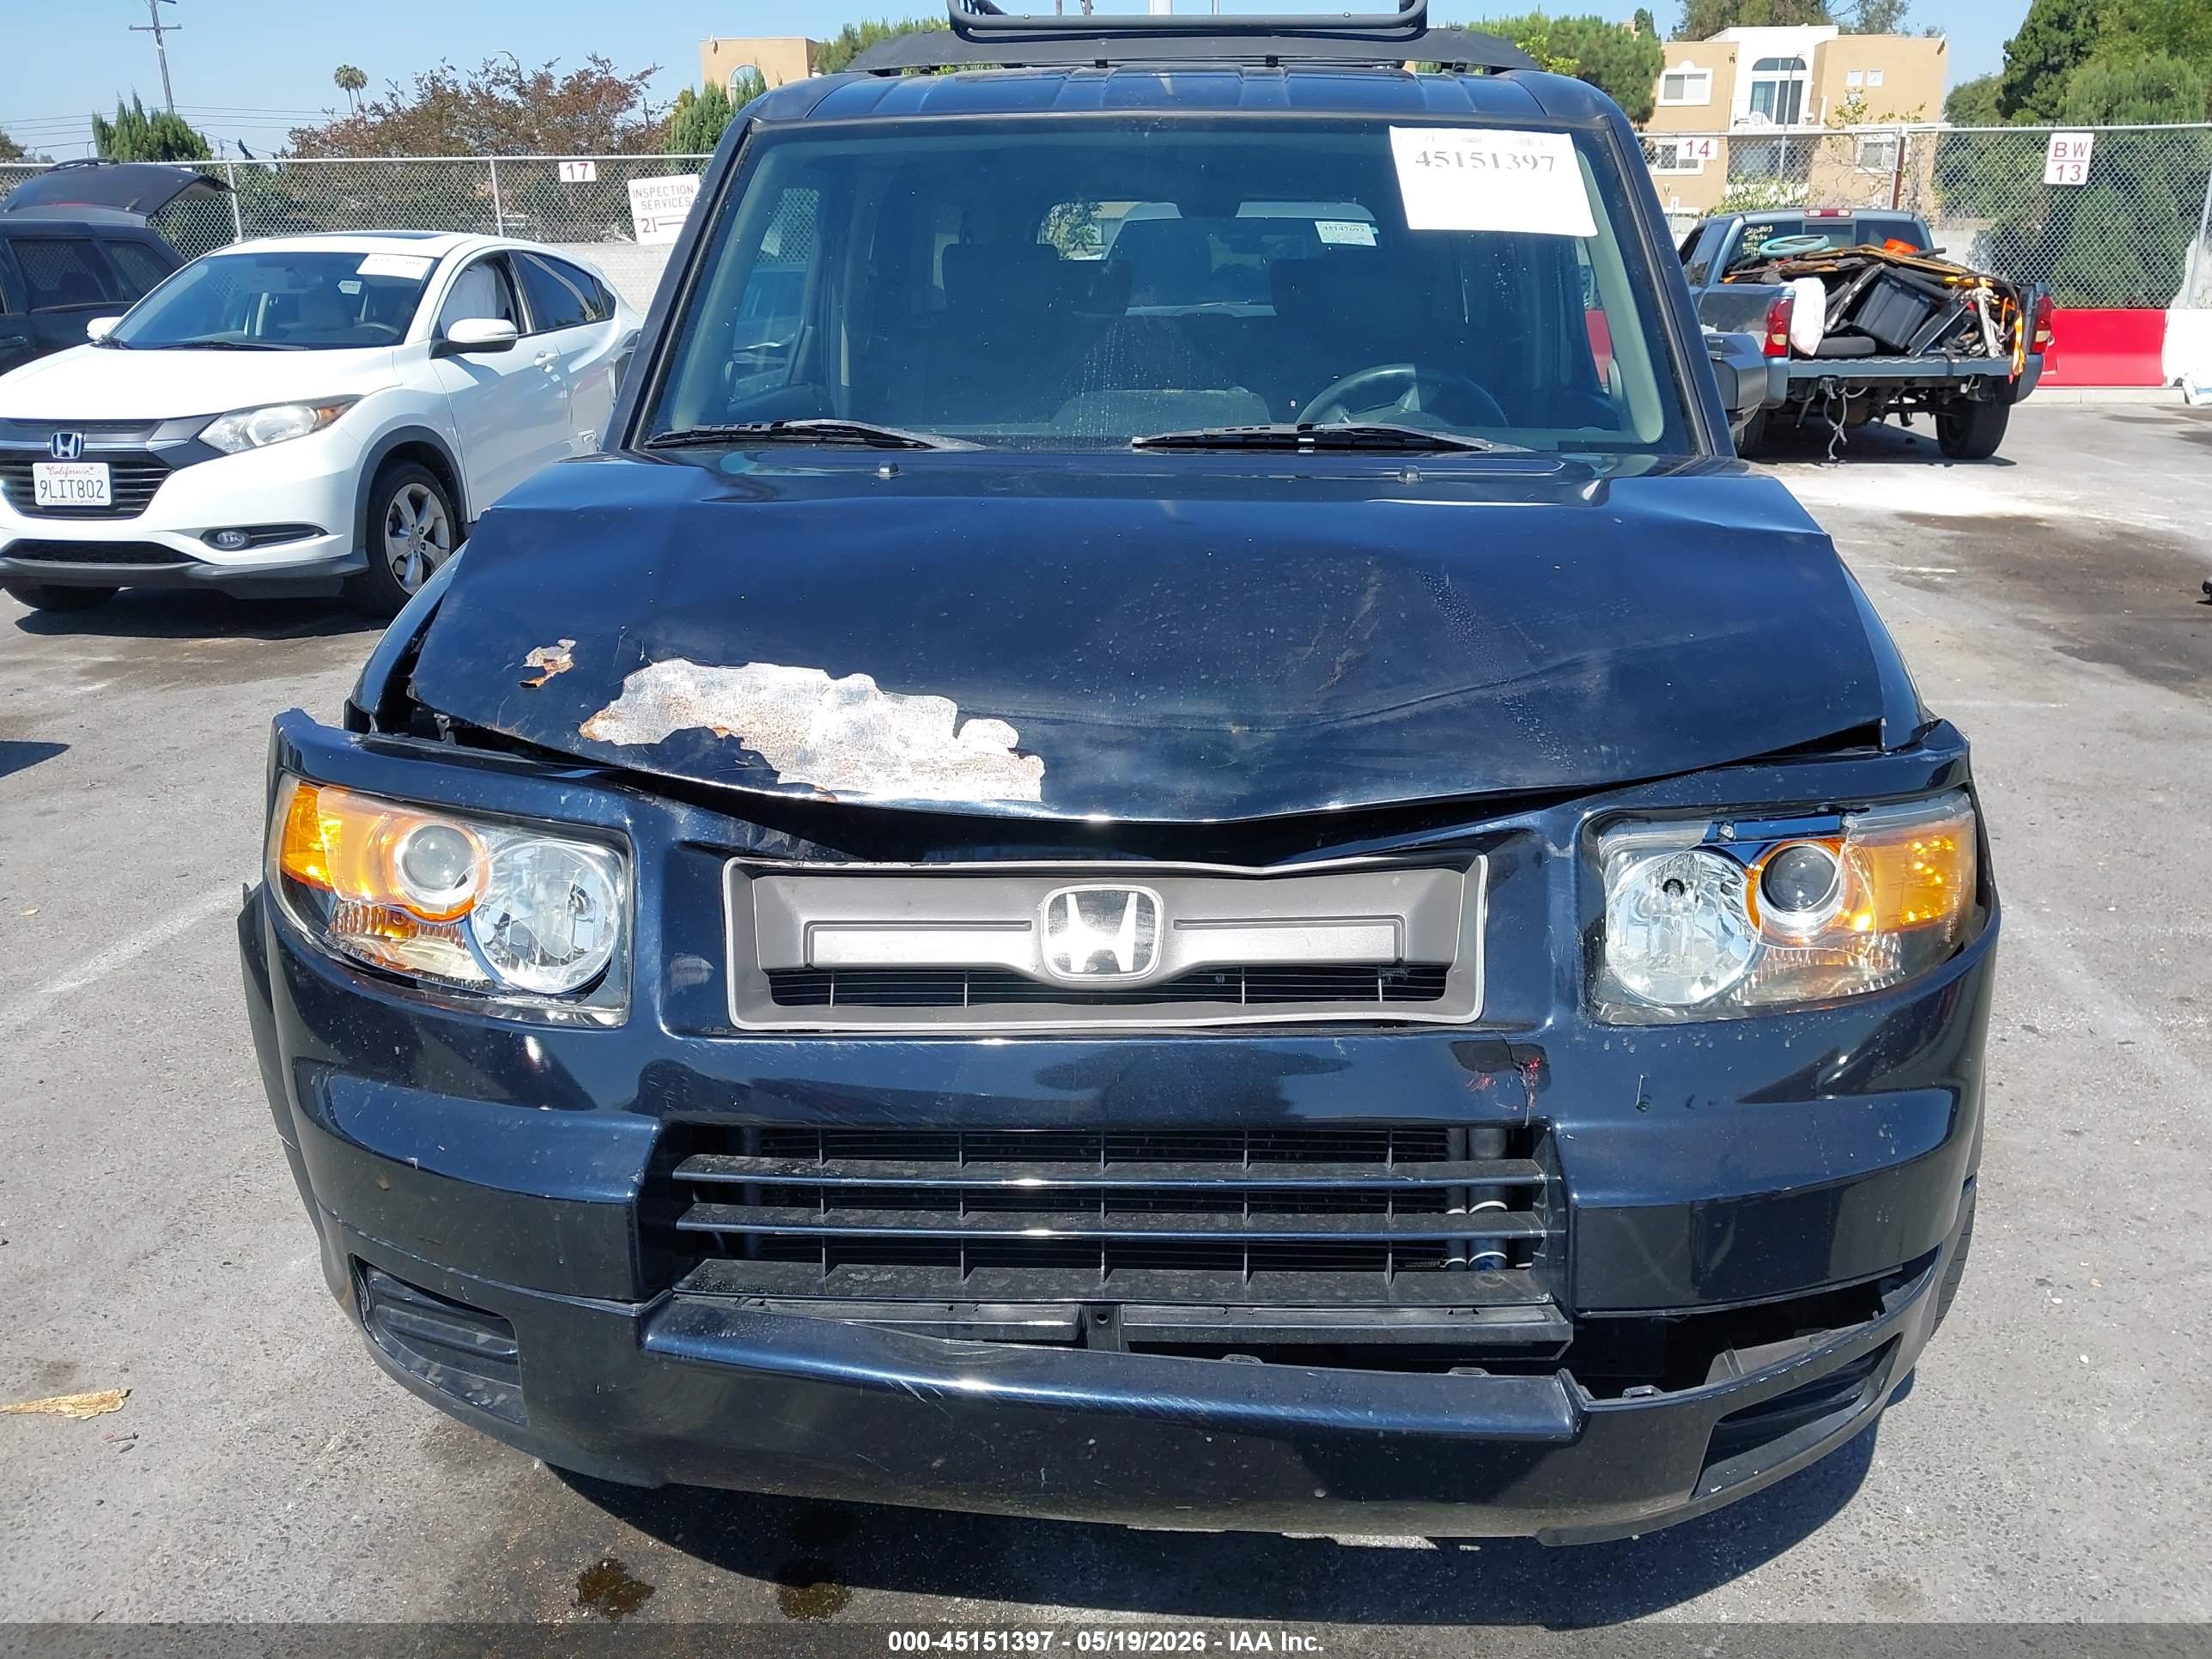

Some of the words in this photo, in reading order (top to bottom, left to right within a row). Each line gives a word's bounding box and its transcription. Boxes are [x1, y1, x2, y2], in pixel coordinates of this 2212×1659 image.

[1685, 139, 1711, 158] 14
[1414, 150, 1555, 173] 45151397
[567, 162, 589, 180] 17
[2055, 163, 2081, 182] 13
[632, 185, 695, 199] INSPECTION
[641, 197, 691, 211] SERVICES
[48, 465, 94, 478] California
[40, 479, 105, 499] 9LIT802
